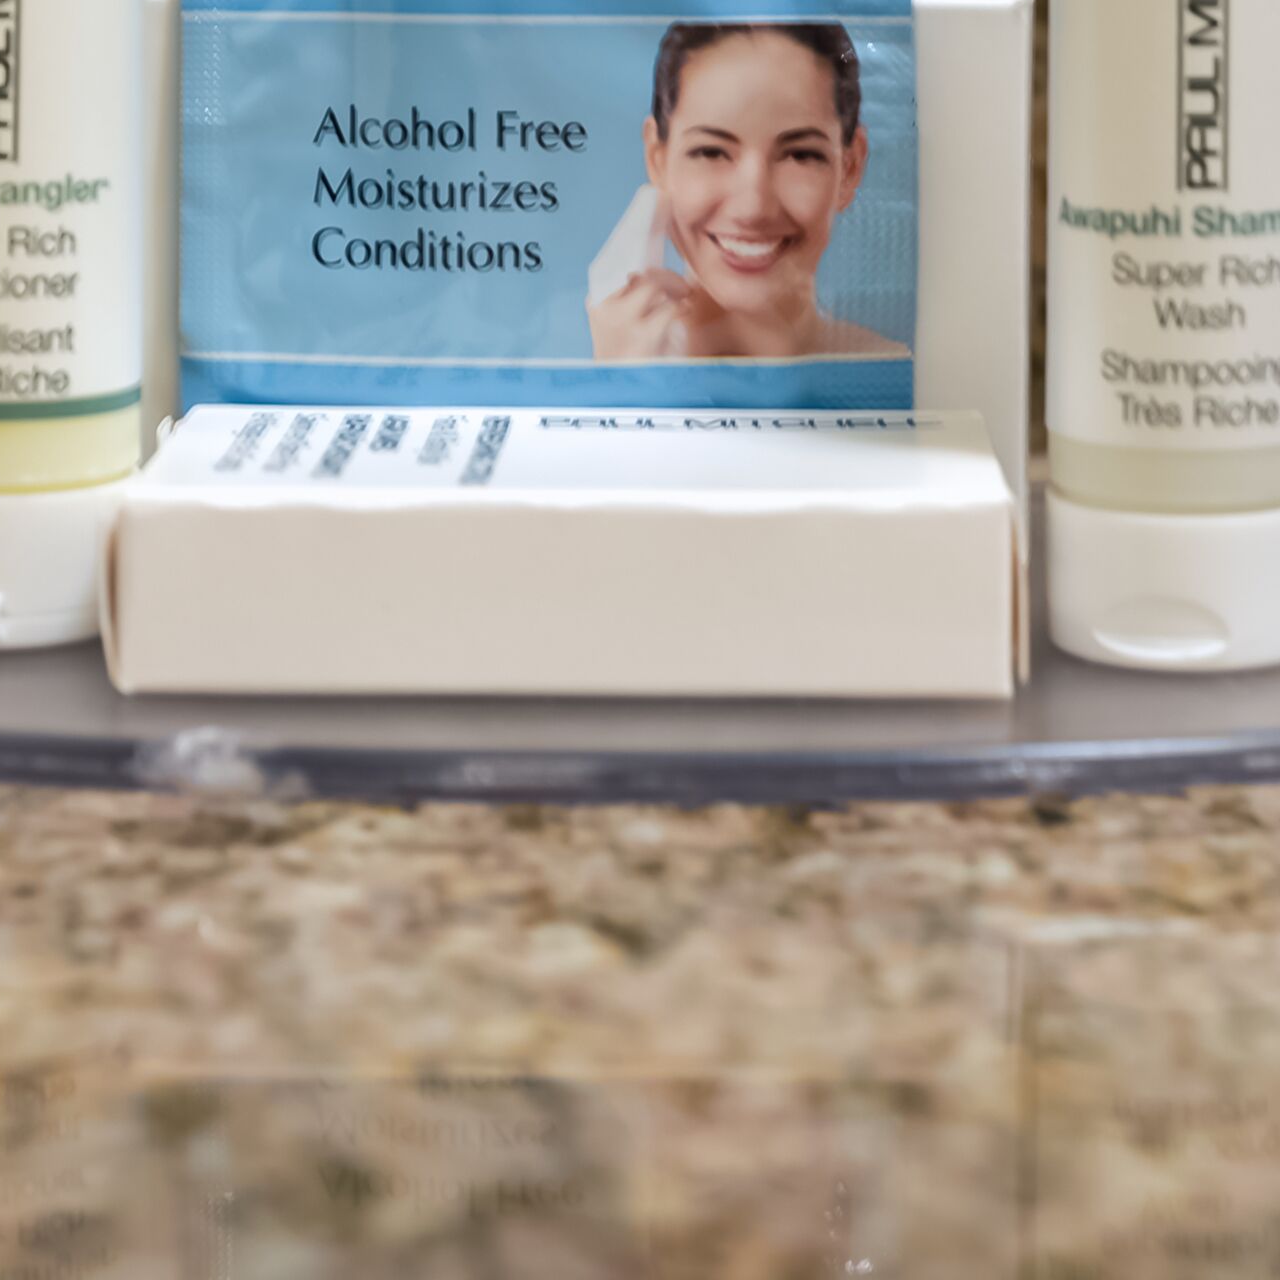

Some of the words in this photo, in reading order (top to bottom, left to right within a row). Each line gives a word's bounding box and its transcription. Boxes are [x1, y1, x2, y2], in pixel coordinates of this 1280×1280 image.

[313, 104, 477, 152] Alcohol
[496, 109, 588, 153] Free
[1185, 56, 1221, 189] PAUL
[313, 167, 560, 212] Moisturizes
[7, 225, 77, 257] Rich
[312, 226, 543, 272] Conditions
[1112, 251, 1205, 294] Super
[1153, 297, 1246, 329] Wash
[1193, 395, 1280, 428] Riche
